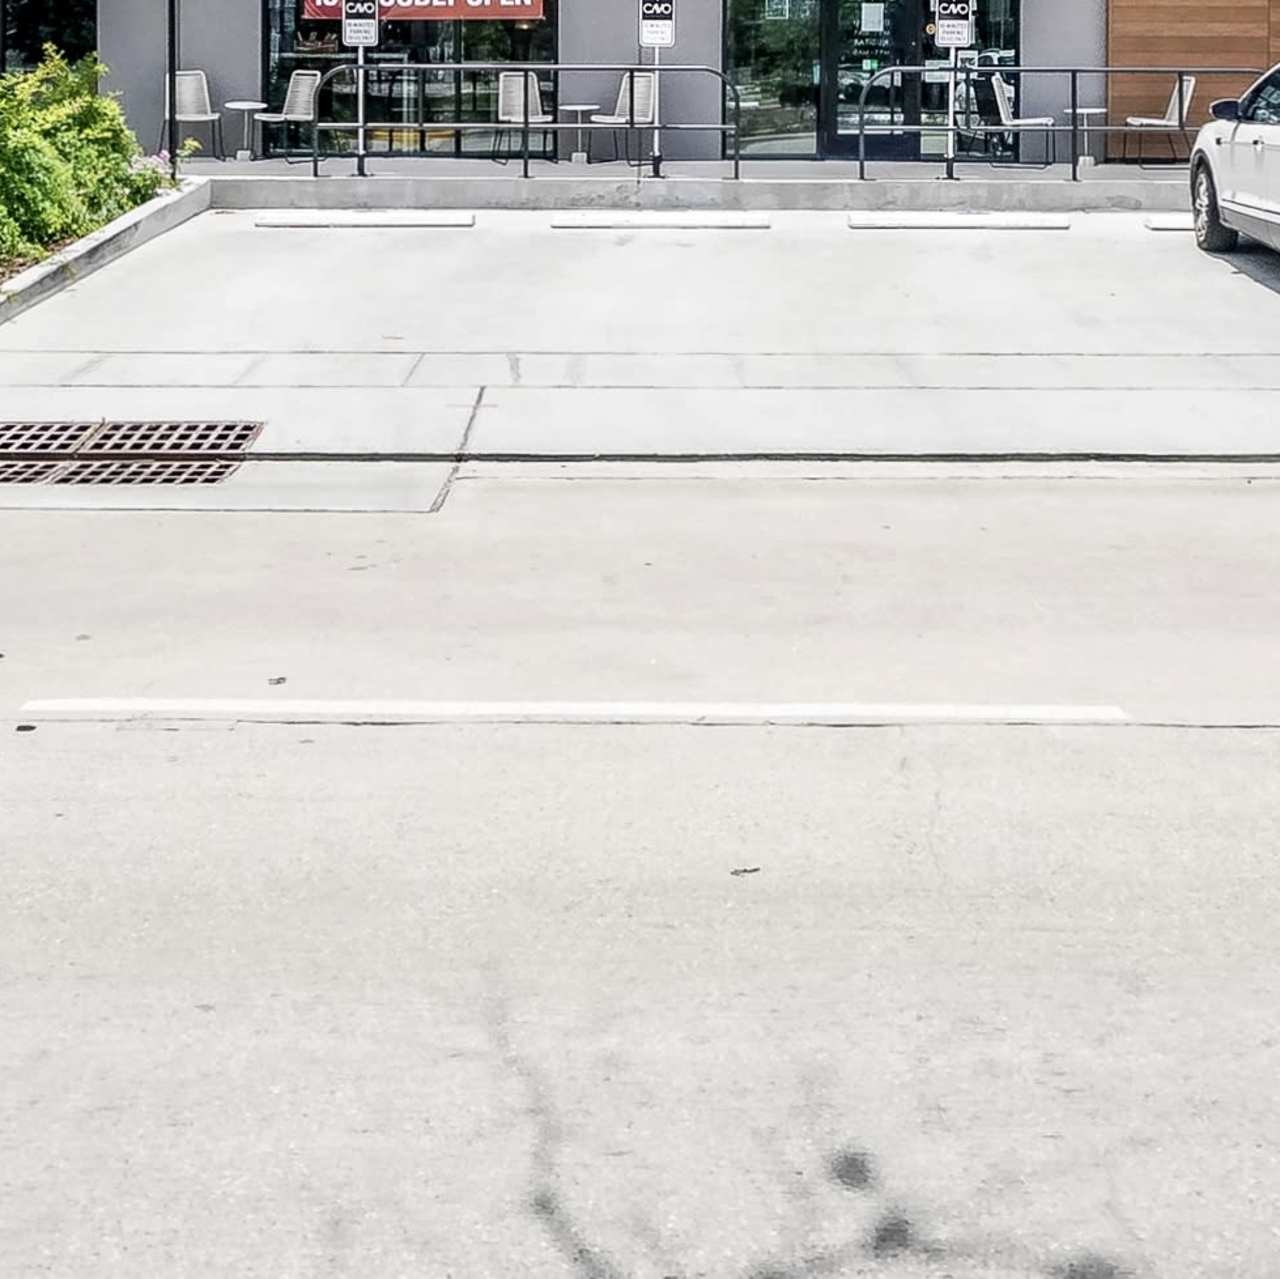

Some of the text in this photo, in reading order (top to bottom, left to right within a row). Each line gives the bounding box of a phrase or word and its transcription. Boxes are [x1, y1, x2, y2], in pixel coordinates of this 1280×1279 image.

[346, 2, 375, 13] CAVO
[643, 3, 672, 14] CAVO
[940, 3, 969, 15] CAVO
